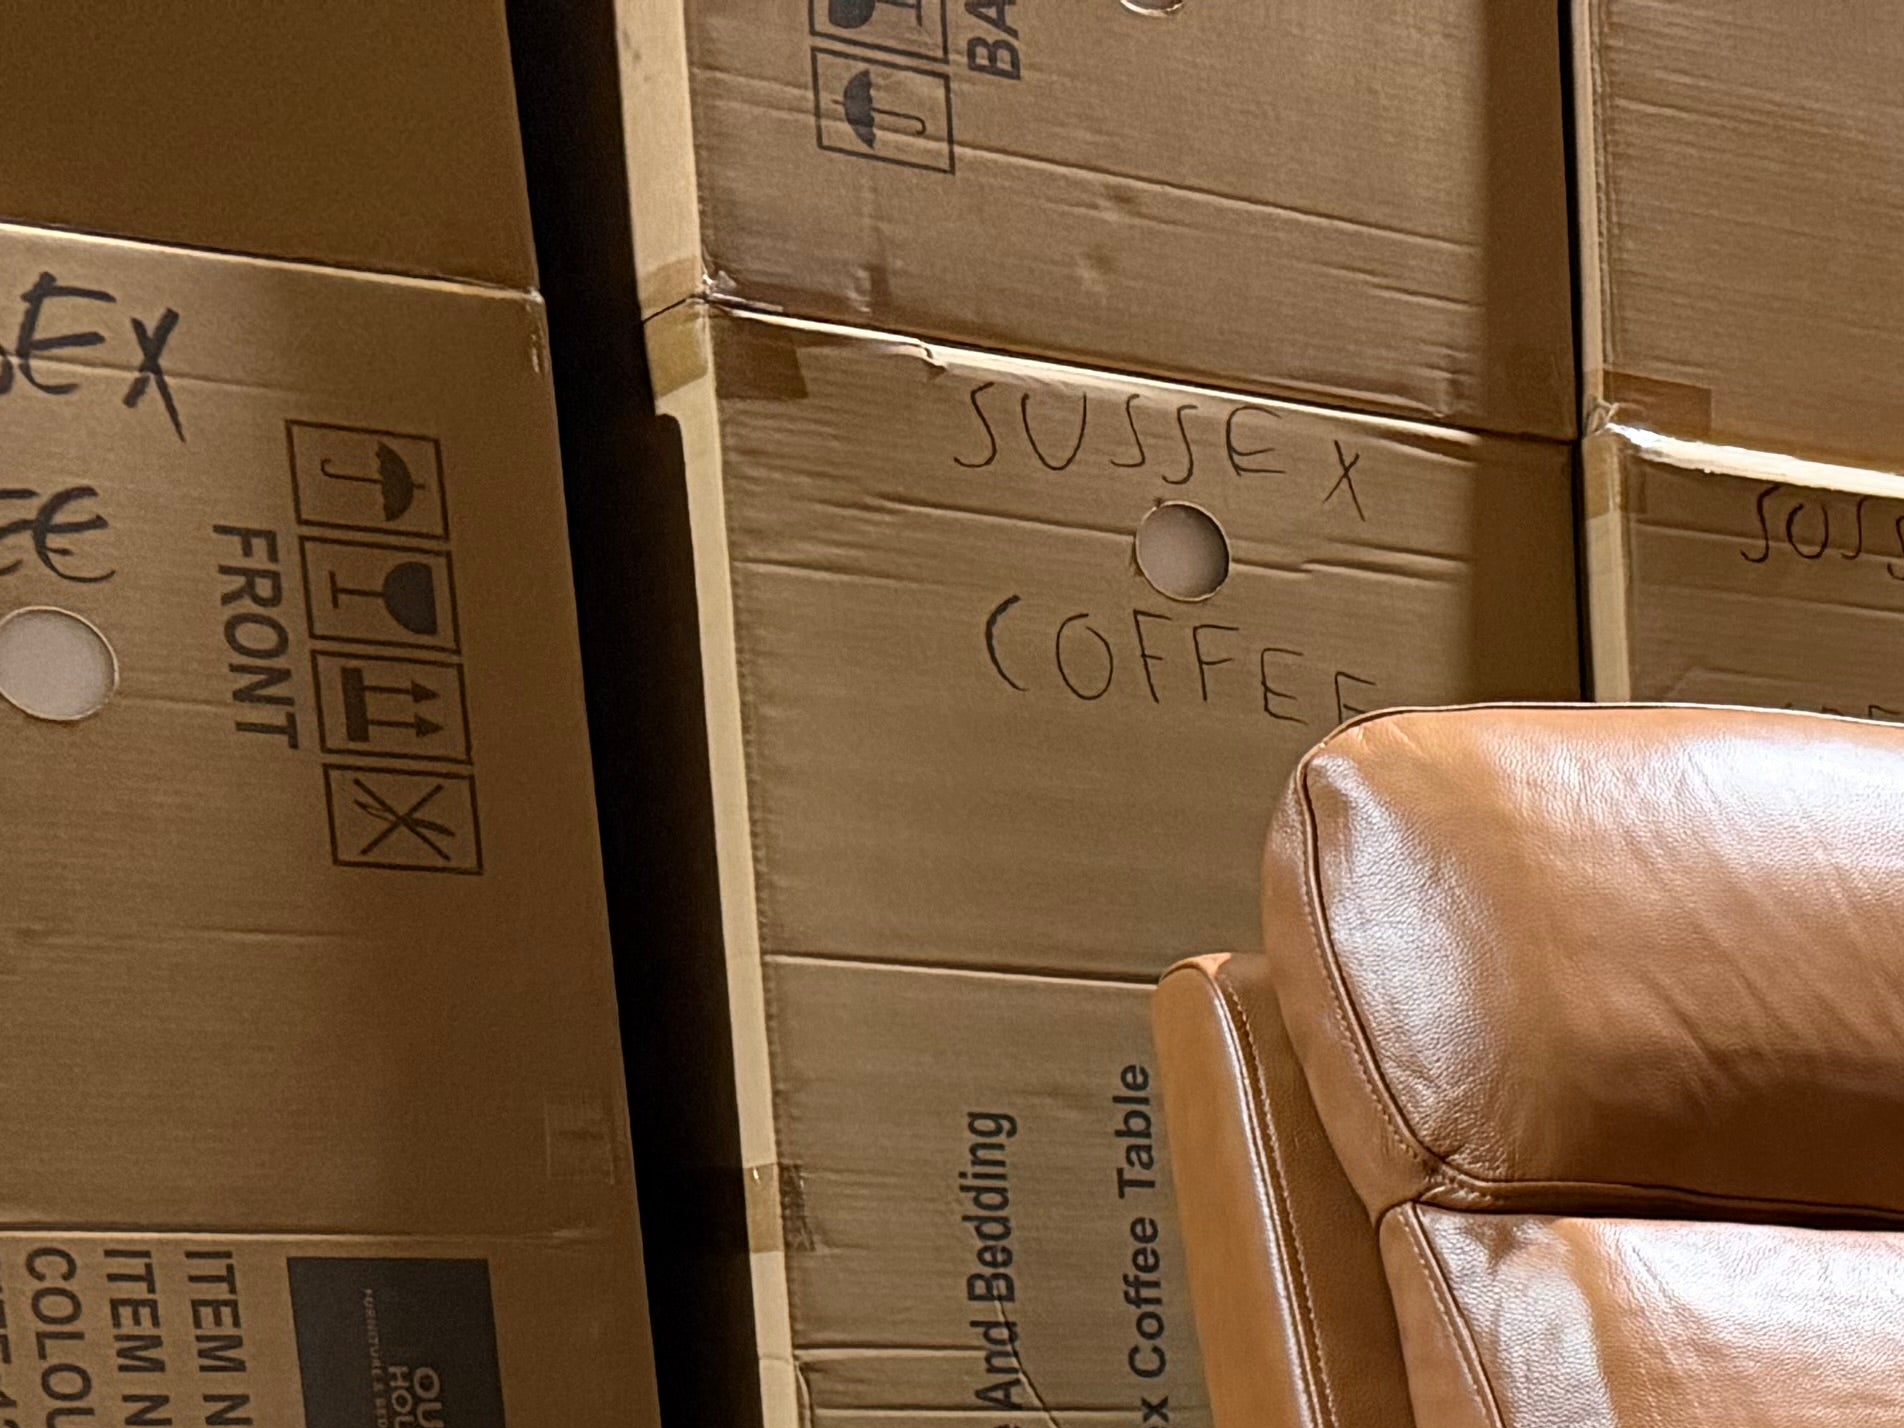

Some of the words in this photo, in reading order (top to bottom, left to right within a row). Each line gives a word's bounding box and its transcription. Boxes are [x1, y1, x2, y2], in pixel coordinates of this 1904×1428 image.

[952, 381, 1366, 522] SUSSEX
[212, 524, 300, 751] FRONT
[1112, 1062, 1157, 1200] Table
[958, 1110, 1018, 1304] Bedding
[103, 1250, 166, 1373] ITEM
[185, 1250, 247, 1373] ITEM
[969, 1319, 1023, 1412] And
[1122, 1216, 1167, 1379] Coffee
